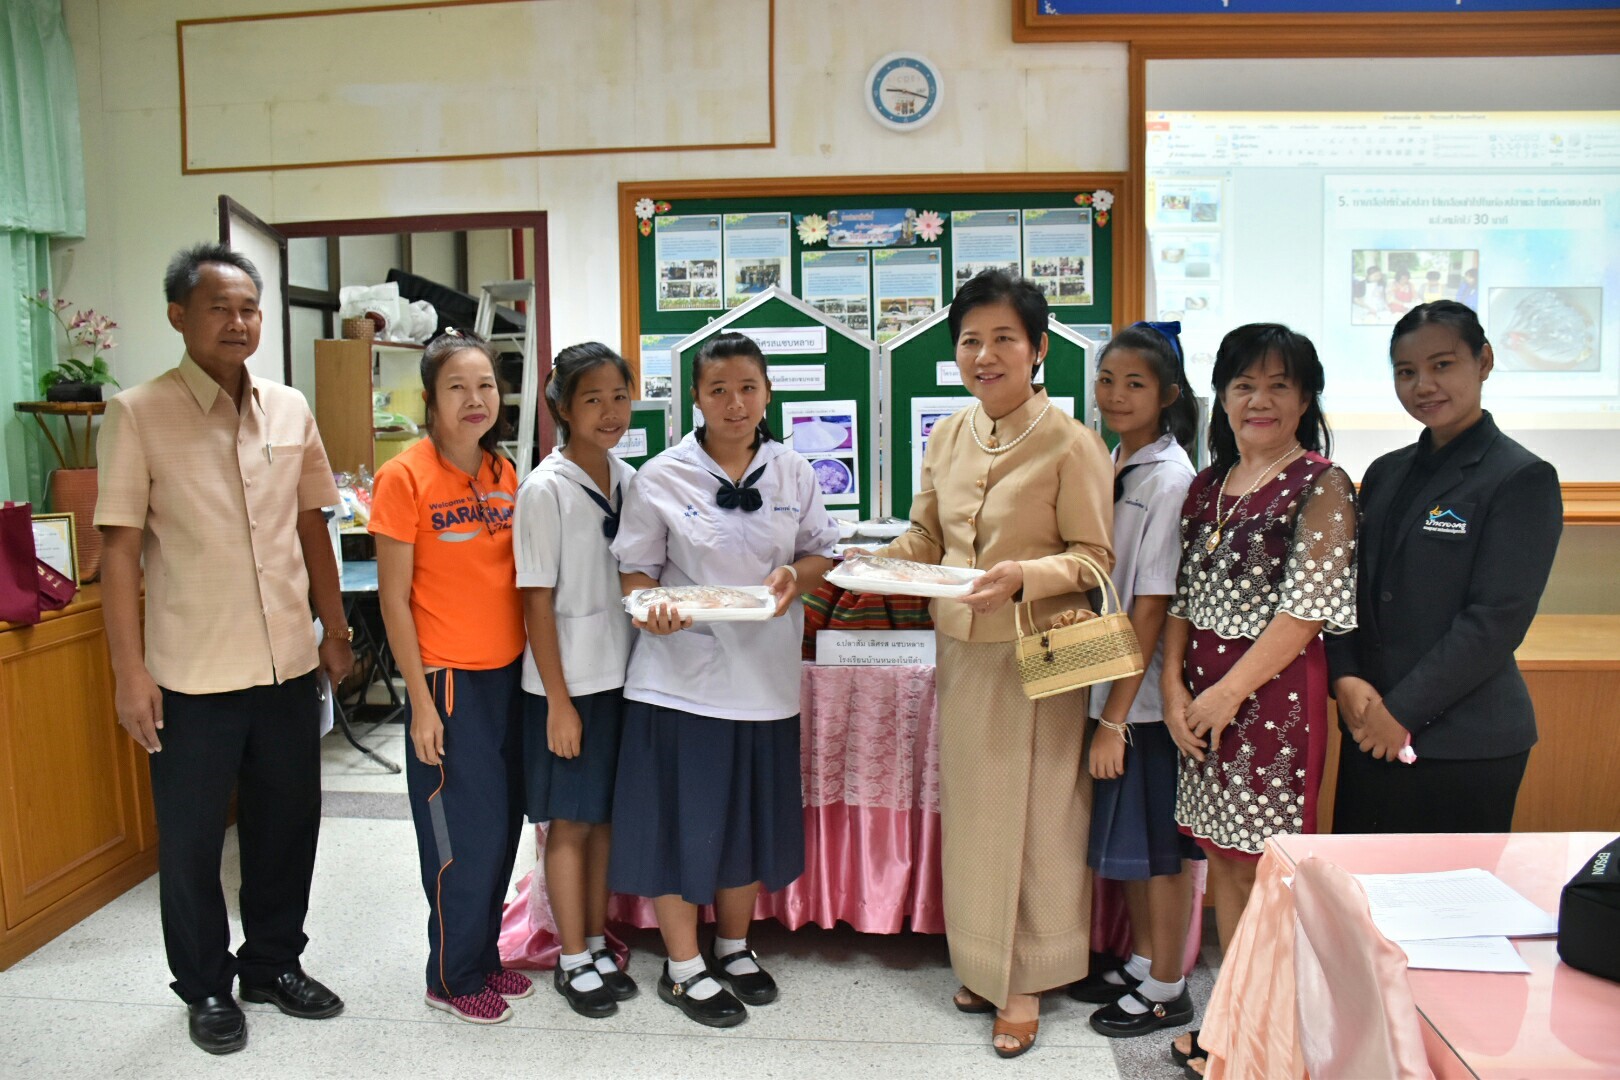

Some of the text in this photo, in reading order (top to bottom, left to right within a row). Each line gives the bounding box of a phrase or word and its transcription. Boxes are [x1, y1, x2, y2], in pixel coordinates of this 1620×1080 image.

[1338, 196, 1349, 207] 5.
[1474, 213, 1489, 225] 30
[429, 498, 466, 510] Welcome
[1591, 852, 1611, 875] EPSON
